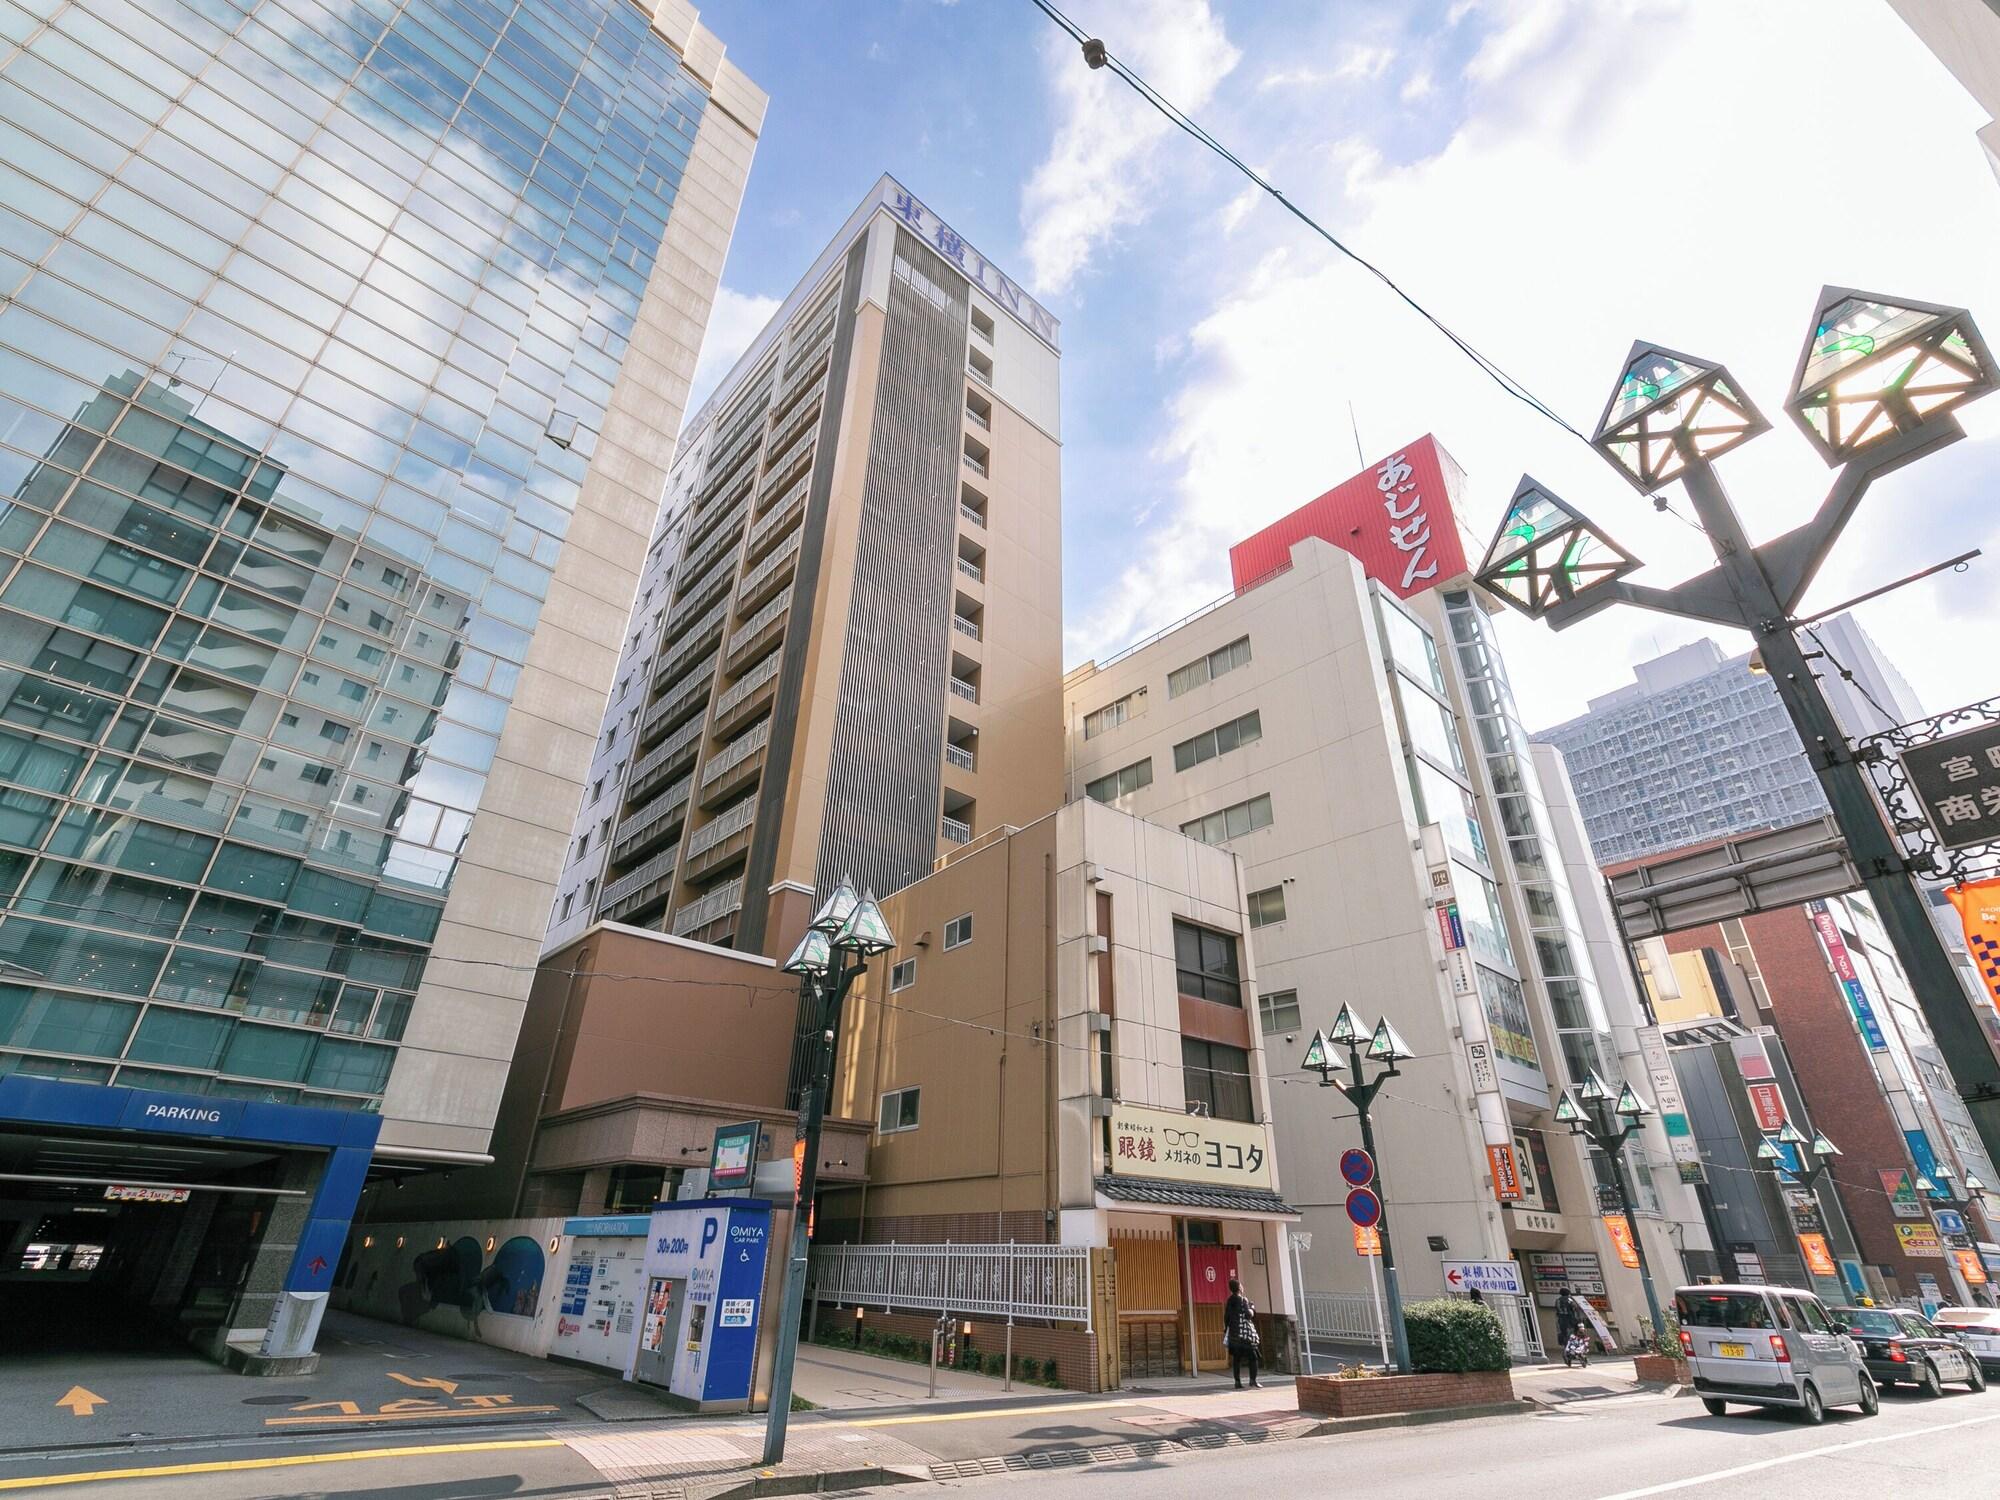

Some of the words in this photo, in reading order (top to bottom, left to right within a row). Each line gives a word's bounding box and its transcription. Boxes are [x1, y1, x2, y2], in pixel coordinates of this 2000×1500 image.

[893, 186, 1061, 345] 東横INN
[1376, 453, 1438, 589] あじせん
[1818, 913, 1837, 944] Propia
[146, 1104, 221, 1123] PARKING
[1118, 1136, 1156, 1163] 眼鏡
[1164, 1149, 1200, 1165] メガネの
[1204, 1141, 1264, 1173] ヨコタ
[700, 1217, 718, 1258] P
[731, 1226, 764, 1238] OMIYA
[1462, 1265, 1515, 1279] 東横INN
